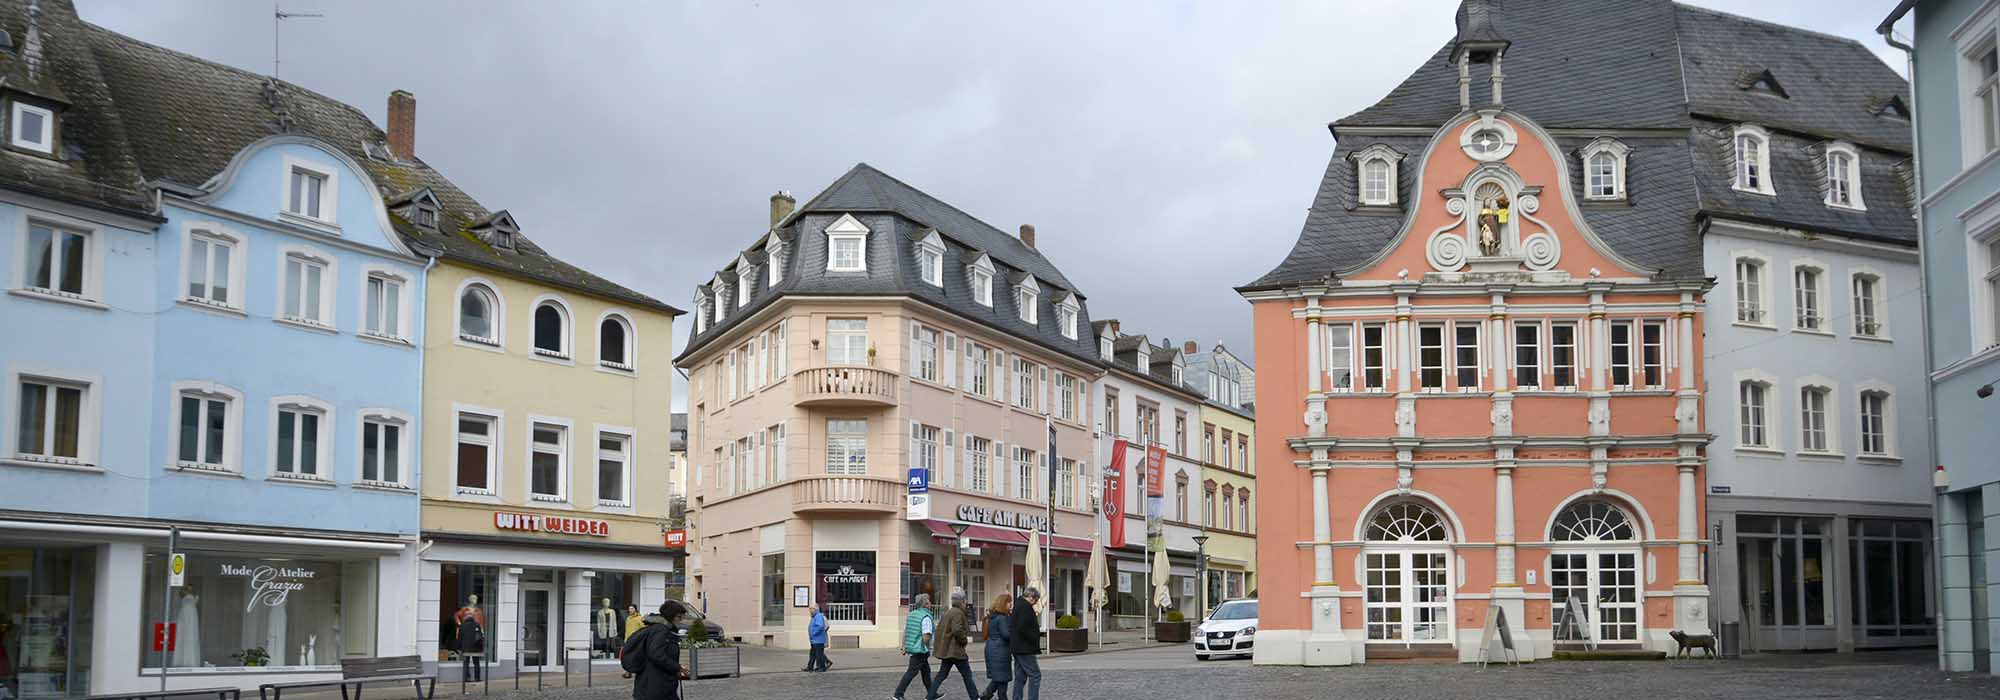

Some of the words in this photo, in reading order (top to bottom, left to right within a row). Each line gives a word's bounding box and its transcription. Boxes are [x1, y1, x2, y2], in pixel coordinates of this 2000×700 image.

[494, 511, 541, 533] WITT
[543, 515, 609, 536] WEIDEN
[995, 509, 1016, 526] AM
[1018, 513, 1056, 531] MAR
[220, 564, 253, 576] Mode
[278, 567, 316, 578] Atelier
[246, 564, 304, 613] Grazia
